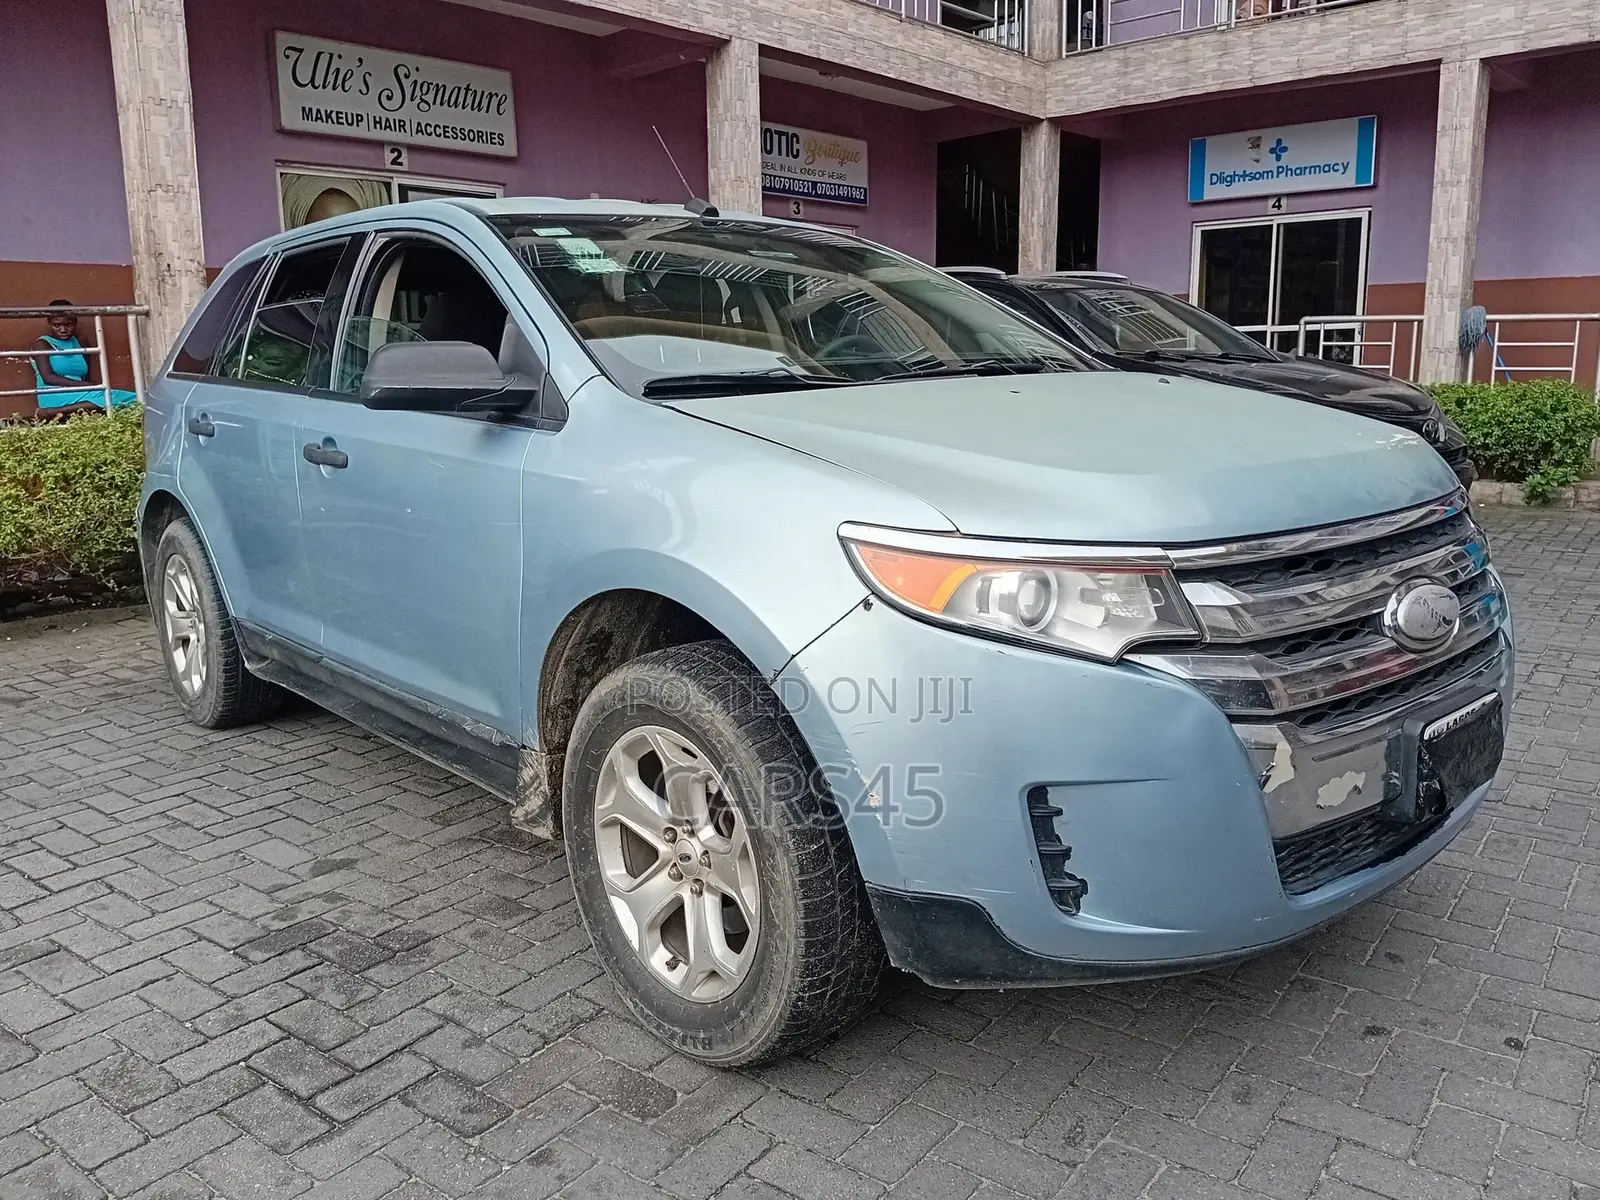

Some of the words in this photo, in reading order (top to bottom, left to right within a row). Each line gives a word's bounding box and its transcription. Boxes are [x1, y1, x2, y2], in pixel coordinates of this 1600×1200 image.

[283, 45, 373, 96] Ulie's
[377, 63, 508, 116] Signature
[301, 106, 365, 128] MAKEUP
[373, 115, 407, 133] HAIR
[415, 121, 505, 146] ACCESSORIES
[761, 127, 800, 159] OTIC
[389, 147, 404, 167] 2
[762, 161, 778, 171] DEAL
[780, 164, 786, 172] IN
[787, 165, 798, 174] ALL
[800, 167, 816, 177] KINDS
[818, 170, 827, 178] OF
[828, 171, 847, 182] WEARS
[1276, 161, 1350, 179] Pharmacy
[792, 201, 801, 216] 3
[1271, 197, 1283, 211] 4
